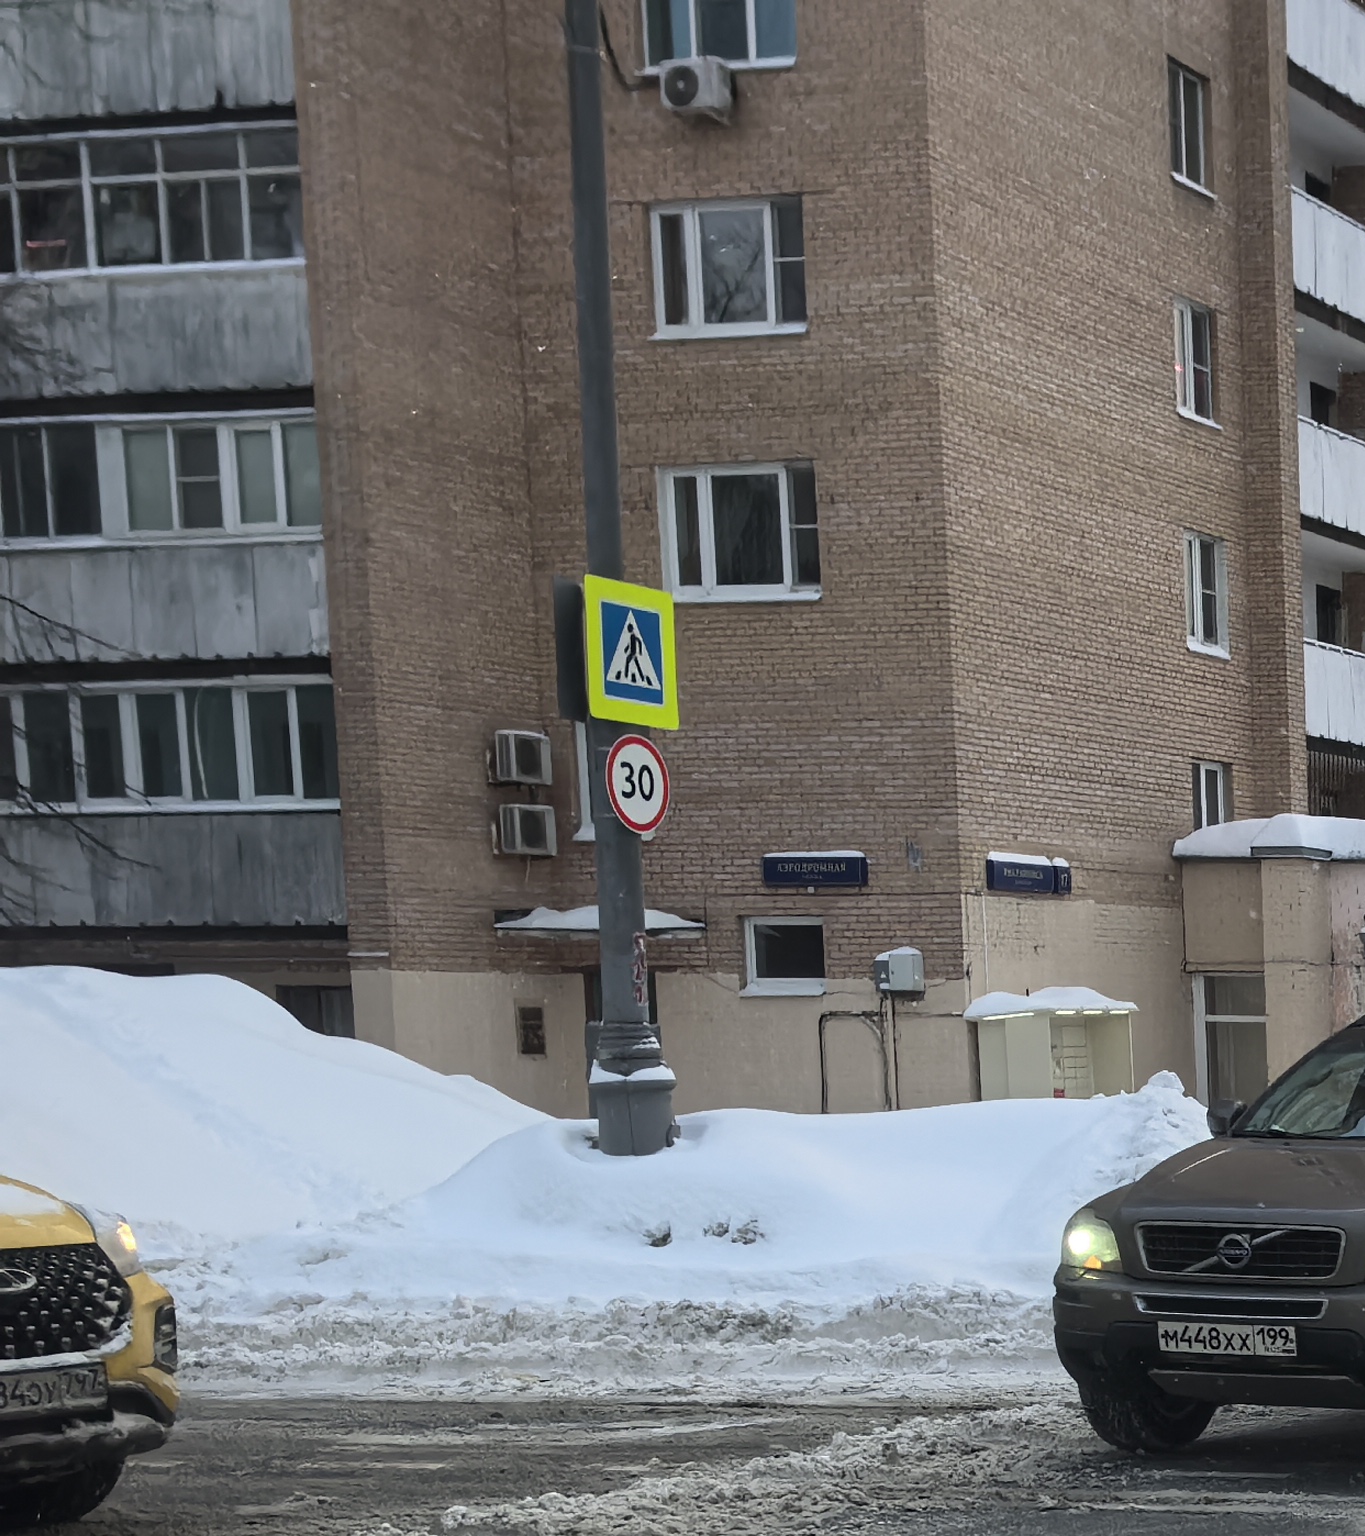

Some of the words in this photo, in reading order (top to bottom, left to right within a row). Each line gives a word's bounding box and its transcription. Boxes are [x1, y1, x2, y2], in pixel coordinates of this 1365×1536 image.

[620, 761, 655, 801] 30
[1163, 1325, 1251, 1352] М448ХХ
[1256, 1327, 1290, 1346] 199
